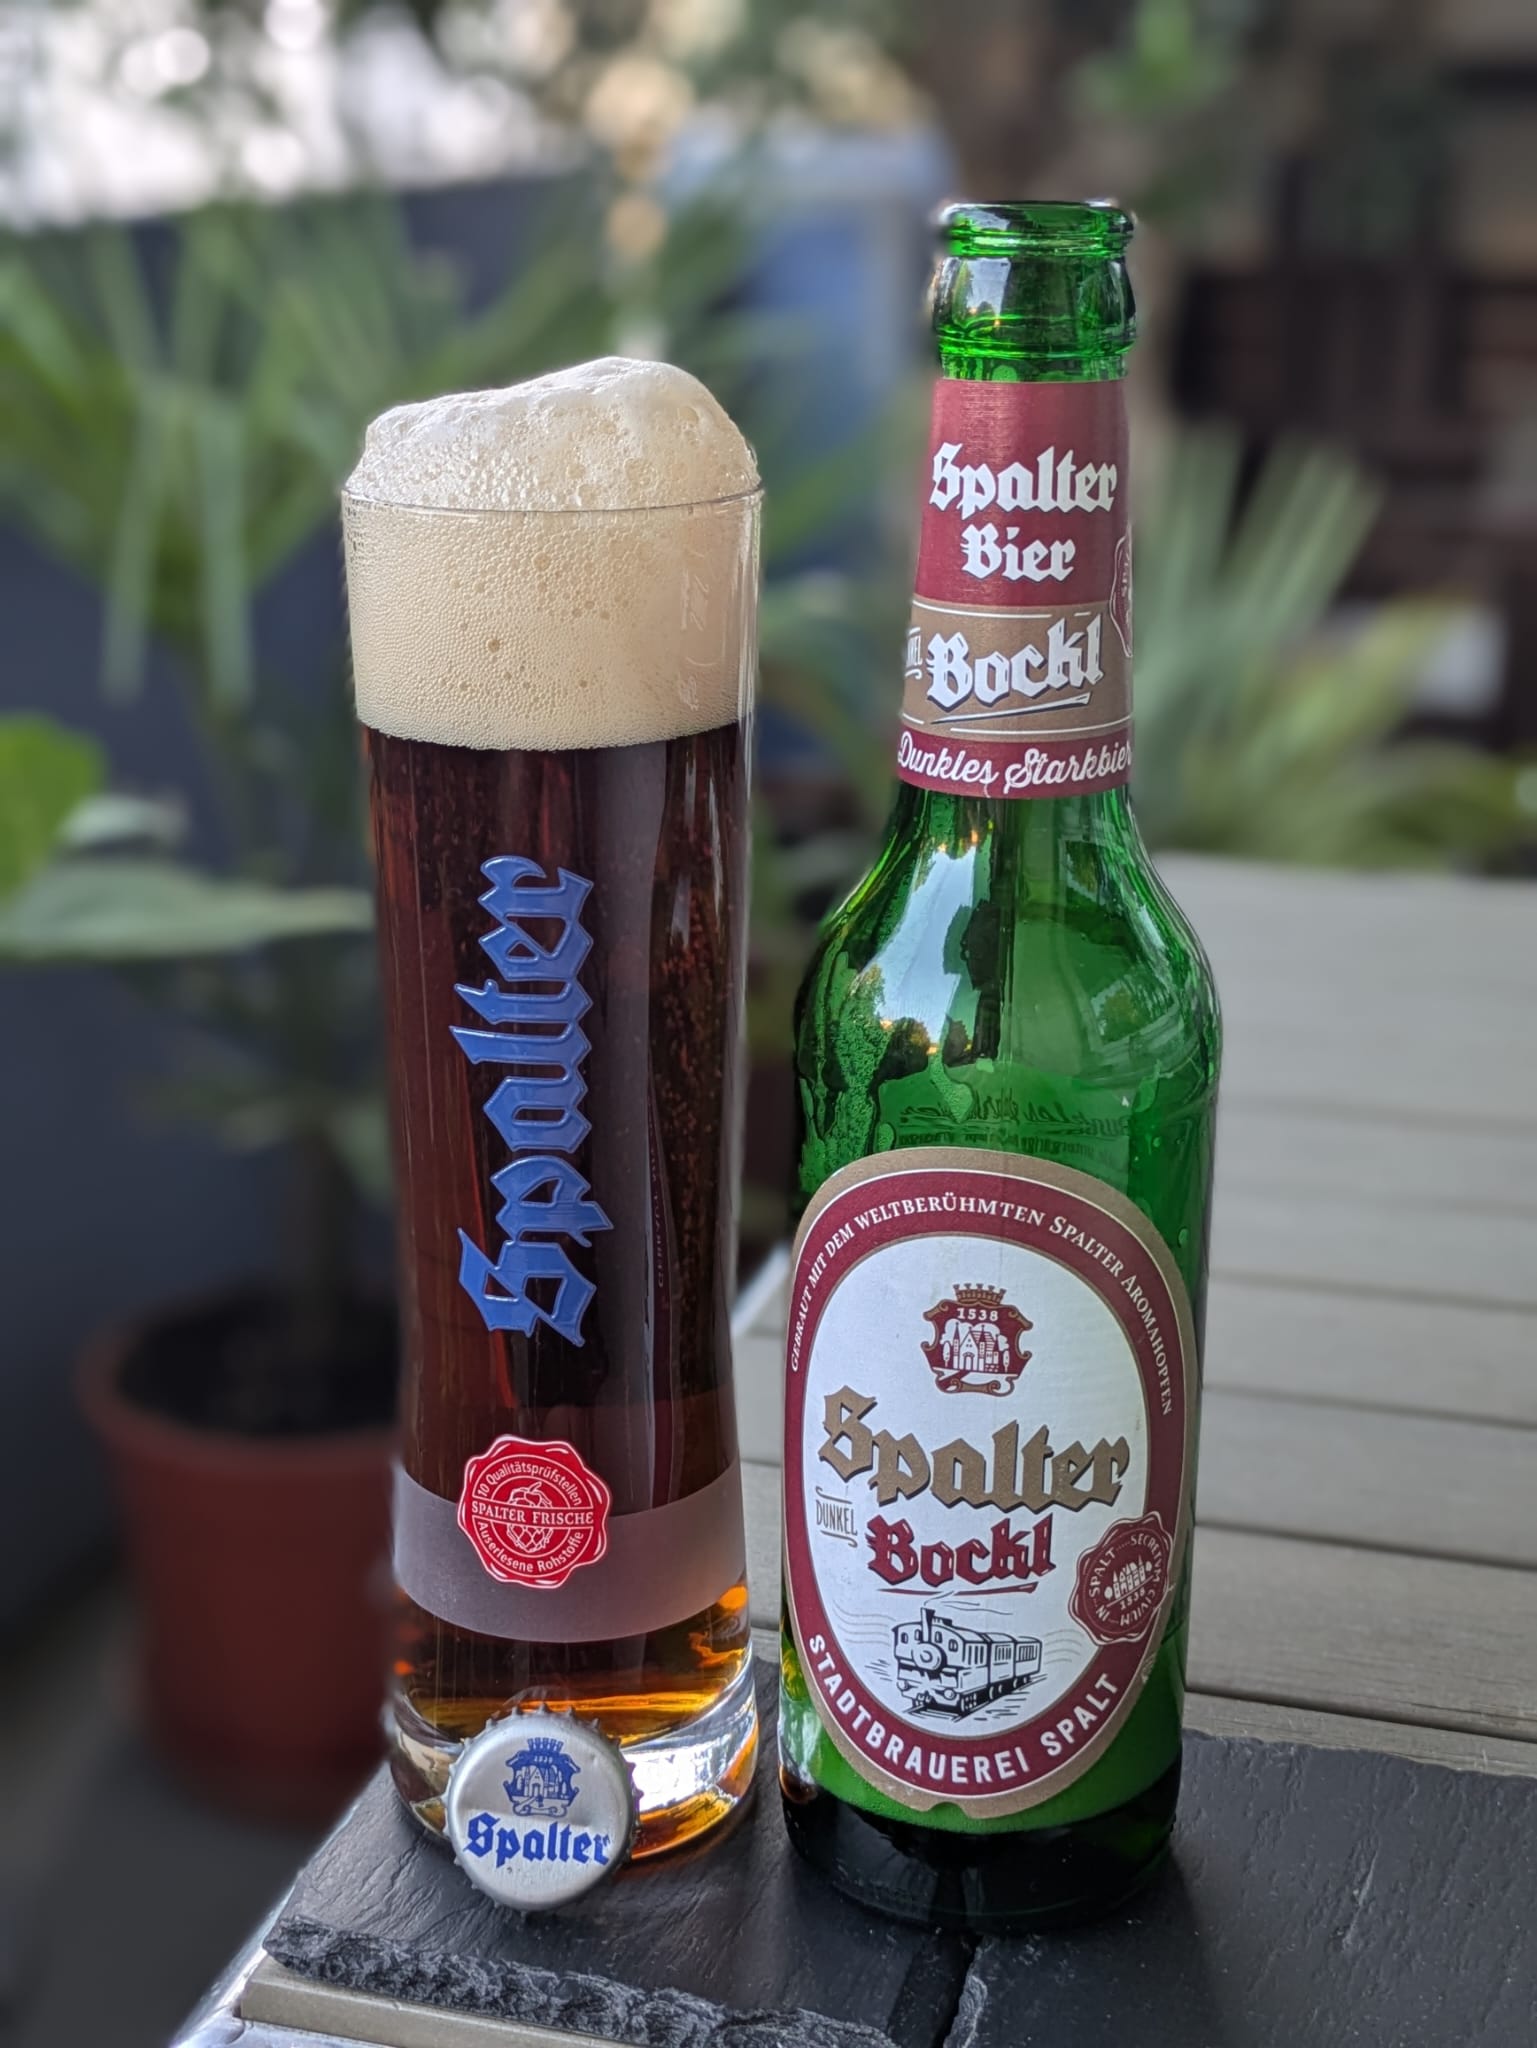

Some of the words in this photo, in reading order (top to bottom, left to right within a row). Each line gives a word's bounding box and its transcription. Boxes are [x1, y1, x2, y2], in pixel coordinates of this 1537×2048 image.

[929, 441, 1117, 519] Spalter
[960, 522, 1076, 581] Bier
[926, 613, 1103, 712] Bockl
[898, 731, 999, 797] Dunkles
[1003, 741, 1132, 794] Starkbier
[449, 855, 614, 1347] Spalter
[788, 1285, 813, 1372] GEBRAUT
[808, 1252, 827, 1289] MIT
[824, 1222, 855, 1258] DEM
[854, 1192, 1046, 1231] WELTBERÜHMTEN
[1050, 1216, 1123, 1277] SPALTER
[1120, 1275, 1172, 1416] AROMAHOPFEN
[957, 1307, 998, 1322] 1538
[818, 1384, 1130, 1514] Spalter
[471, 1500, 526, 1523] SPALTER
[532, 1511, 594, 1525] FRISCHE
[477, 1482, 490, 1497] 10
[486, 1462, 582, 1506] Qualitätsprüfstellen
[478, 1521, 534, 1573] Auserlesene
[537, 1530, 584, 1573] Rohstoffe
[815, 1499, 858, 1537] DUNKEL
[865, 1514, 1056, 1588] Bockl
[1089, 1547, 1115, 1598] SPALT
[1096, 1604, 1110, 1622] IN
[809, 1634, 1029, 1783] STADTBRAUEREI
[1040, 1673, 1119, 1757] SPALT
[463, 1812, 611, 1868] Spalter
